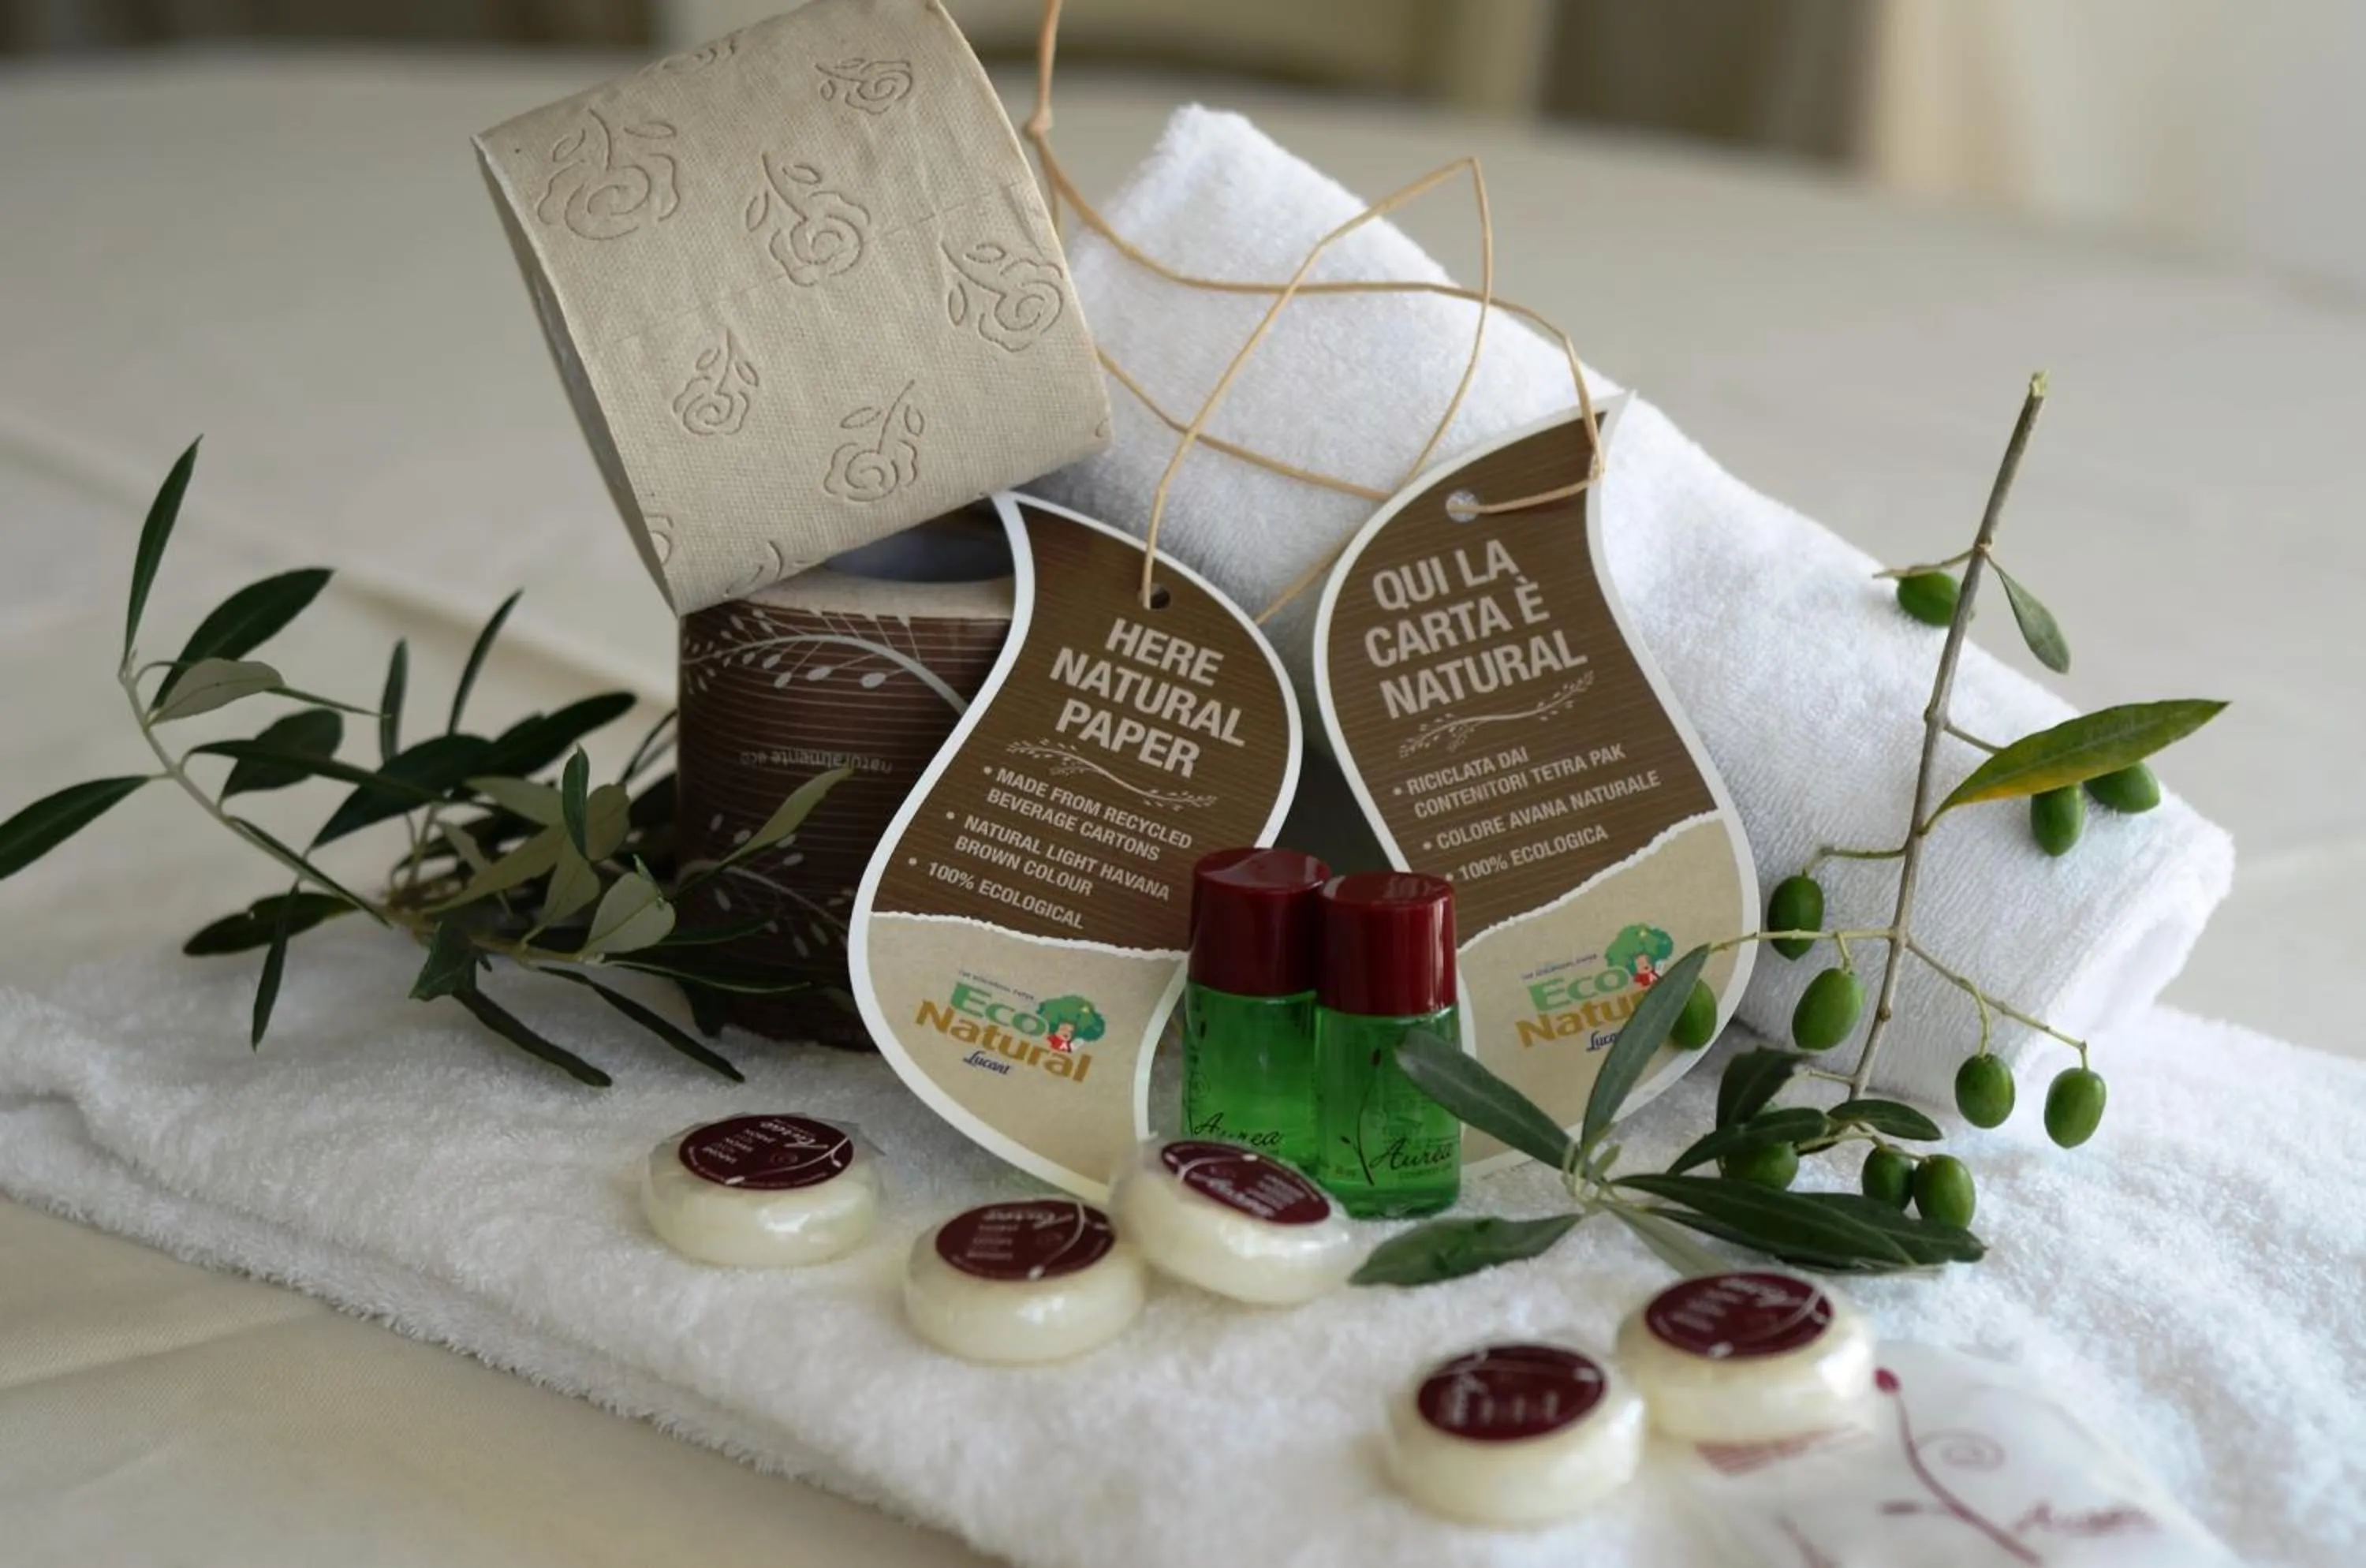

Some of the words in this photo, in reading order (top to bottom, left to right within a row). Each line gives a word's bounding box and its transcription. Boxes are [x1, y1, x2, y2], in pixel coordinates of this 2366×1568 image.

[1372, 556, 1450, 612] QUI
[1455, 539, 1521, 588] LA
[1106, 618, 1224, 687] HERE
[1364, 595, 1512, 668] CARTA
[1516, 575, 1550, 624] È
[1050, 647, 1246, 746] NATURAL
[1379, 629, 1588, 719] NATURAL
[1055, 699, 1200, 778] PAPER
[1407, 757, 1495, 795] RICICLATA
[1498, 746, 1528, 771] DAI
[996, 768, 1047, 798] MADE
[1050, 782, 1101, 817] FROM
[1103, 802, 1192, 850] RECYCLED
[1415, 775, 1528, 819] CONTENITORI
[1530, 757, 1588, 785] TETRA
[1589, 744, 1626, 767] PAK
[1437, 816, 1506, 850] COLORE
[1510, 800, 1567, 829] AVANA
[1571, 770, 1661, 811] NATURALE
[965, 816, 1042, 855] NATURAL
[1046, 844, 1096, 874] LIGHT
[1100, 861, 1170, 902] HAVANA
[987, 790, 1078, 831] BEVERAGE
[1080, 822, 1159, 861] CARTONS
[1460, 855, 1508, 883] 100%
[1512, 825, 1609, 866] ECOLOGICA
[928, 861, 974, 890] 100%
[979, 879, 1084, 929] ECOLOGICAL
[955, 836, 1020, 875] BROWN
[1023, 861, 1093, 896] COLOUR
[950, 981, 1048, 1036] Eco
[1515, 990, 1645, 1048] Natu
[1527, 967, 1629, 1012] Eco
[916, 999, 1092, 1083] Natural
